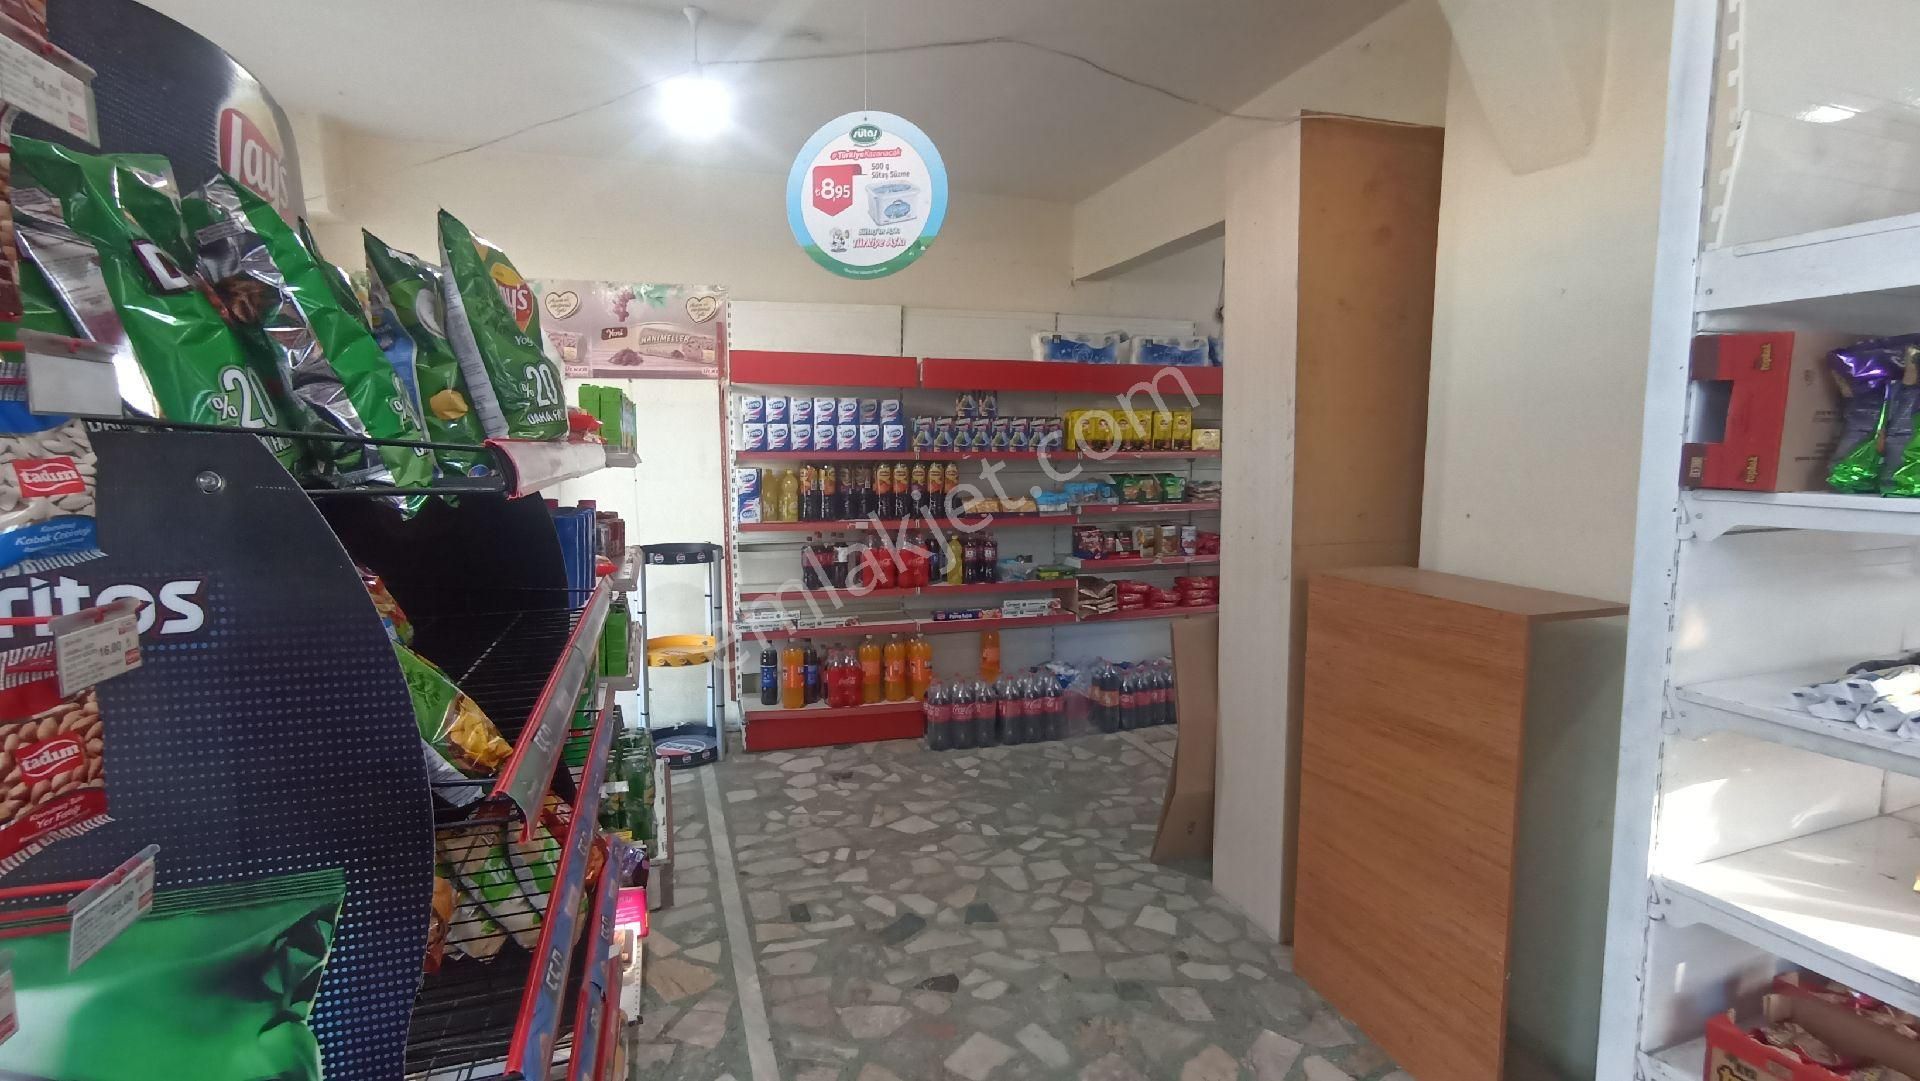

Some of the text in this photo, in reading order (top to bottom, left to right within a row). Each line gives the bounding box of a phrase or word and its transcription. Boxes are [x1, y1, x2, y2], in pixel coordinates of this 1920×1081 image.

[606, 329, 624, 338] Yeni
[641, 334, 690, 345] HANIMELLER
[20, 469, 79, 484] tadım
[22, 745, 79, 771] tadım
